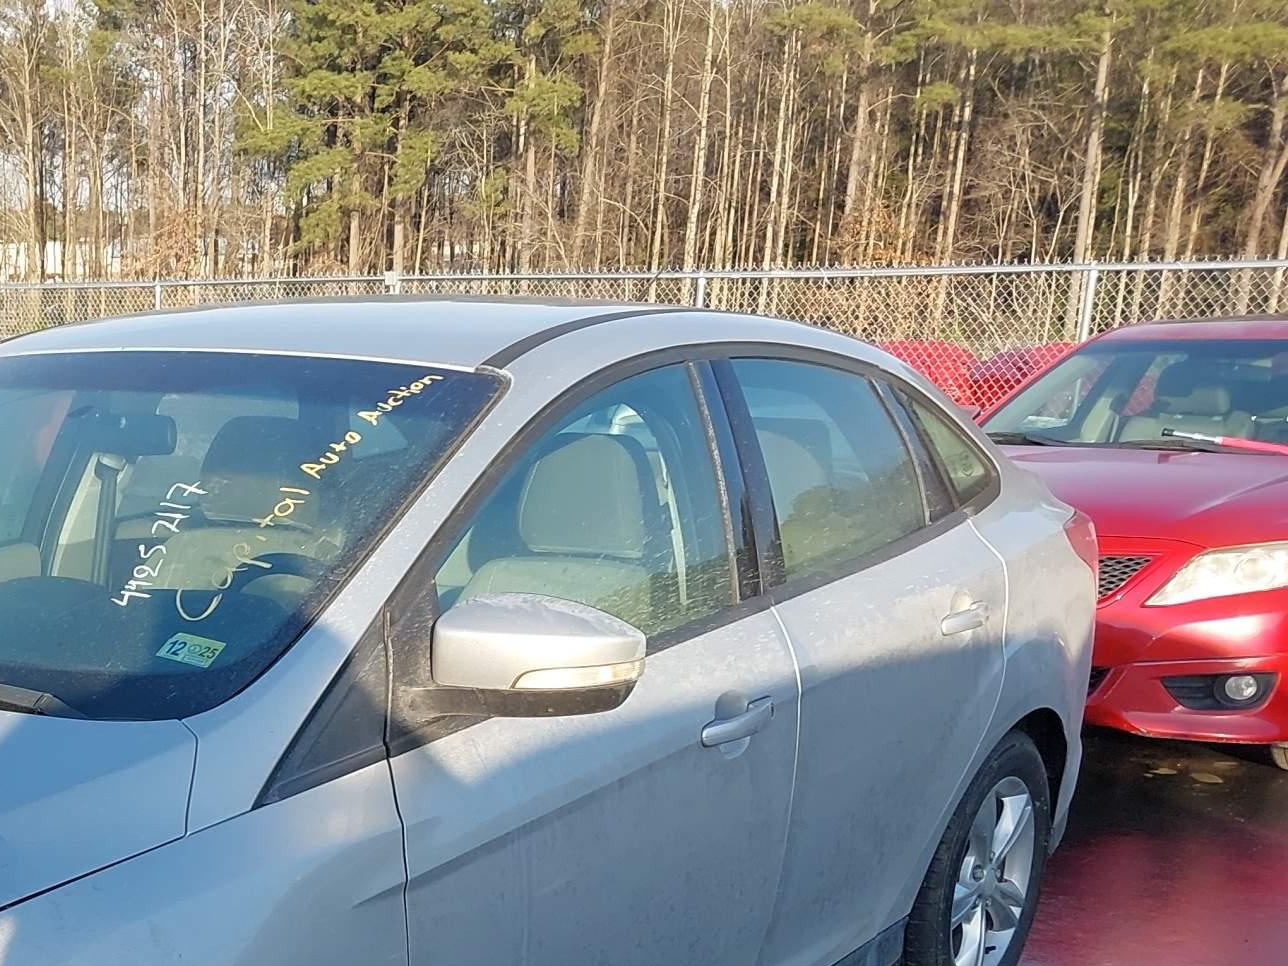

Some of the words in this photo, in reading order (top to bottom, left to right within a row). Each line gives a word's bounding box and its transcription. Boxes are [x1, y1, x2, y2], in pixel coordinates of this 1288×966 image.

[300, 431, 362, 479] Auto
[357, 375, 444, 426] Auction
[166, 640, 187, 656] 12
[199, 646, 218, 659] 25
